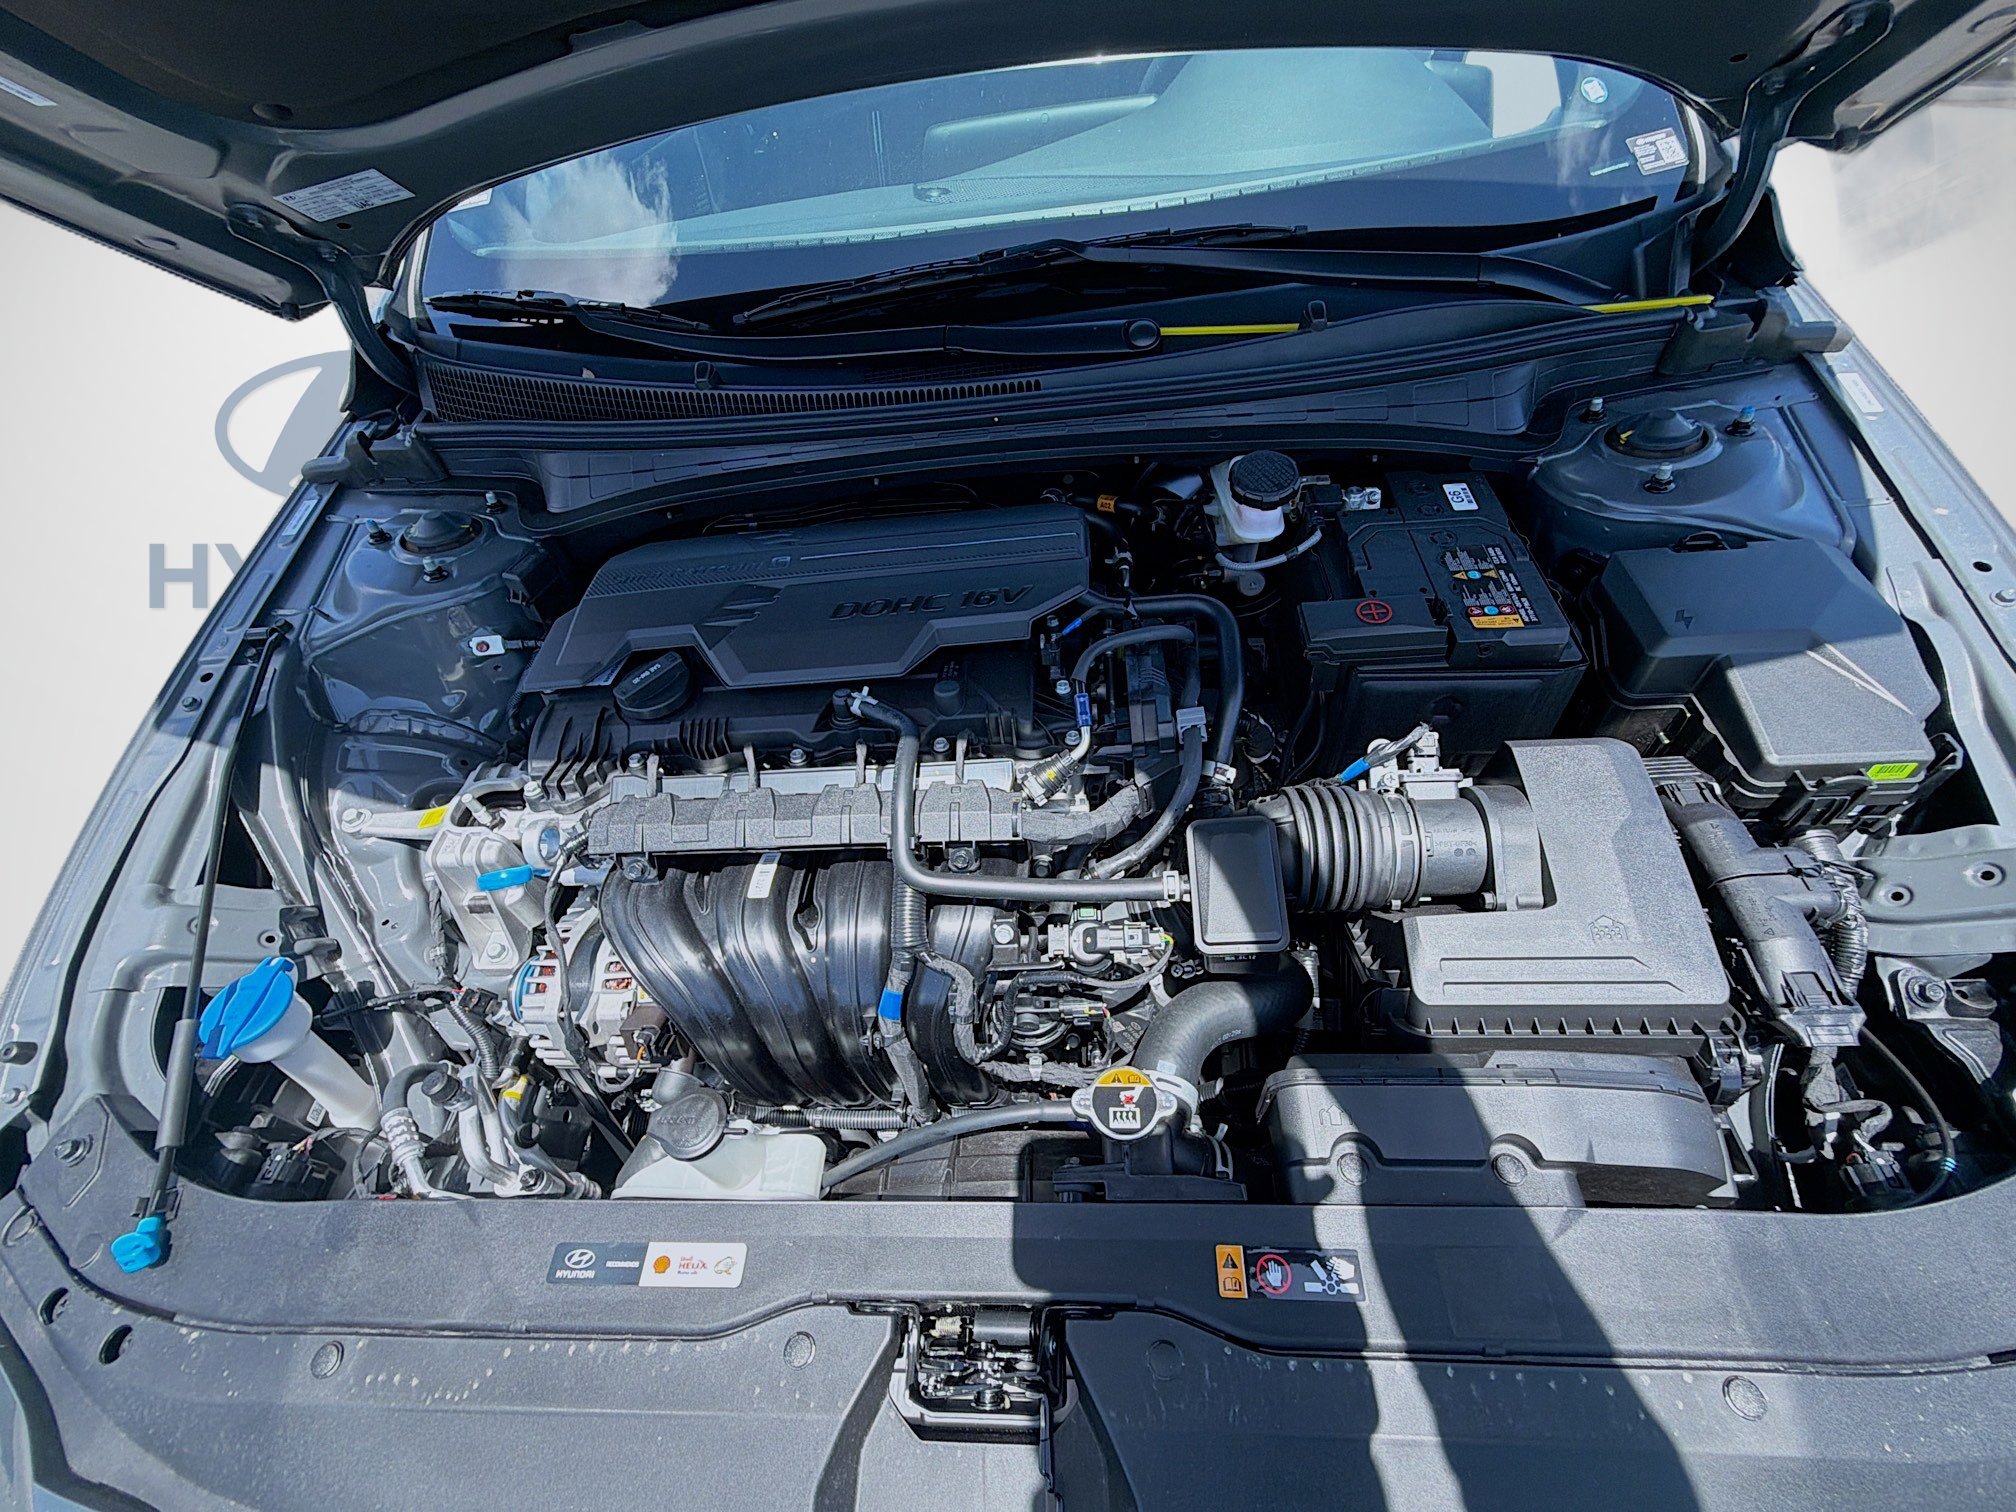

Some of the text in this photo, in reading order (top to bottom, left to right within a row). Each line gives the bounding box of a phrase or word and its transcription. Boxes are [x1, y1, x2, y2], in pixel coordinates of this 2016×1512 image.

[1448, 490, 1465, 503] G6
[829, 584, 1033, 621] DOHC 16V
[678, 1260, 707, 1270] HELIX
[555, 1269, 595, 1279] HYUNDAI
